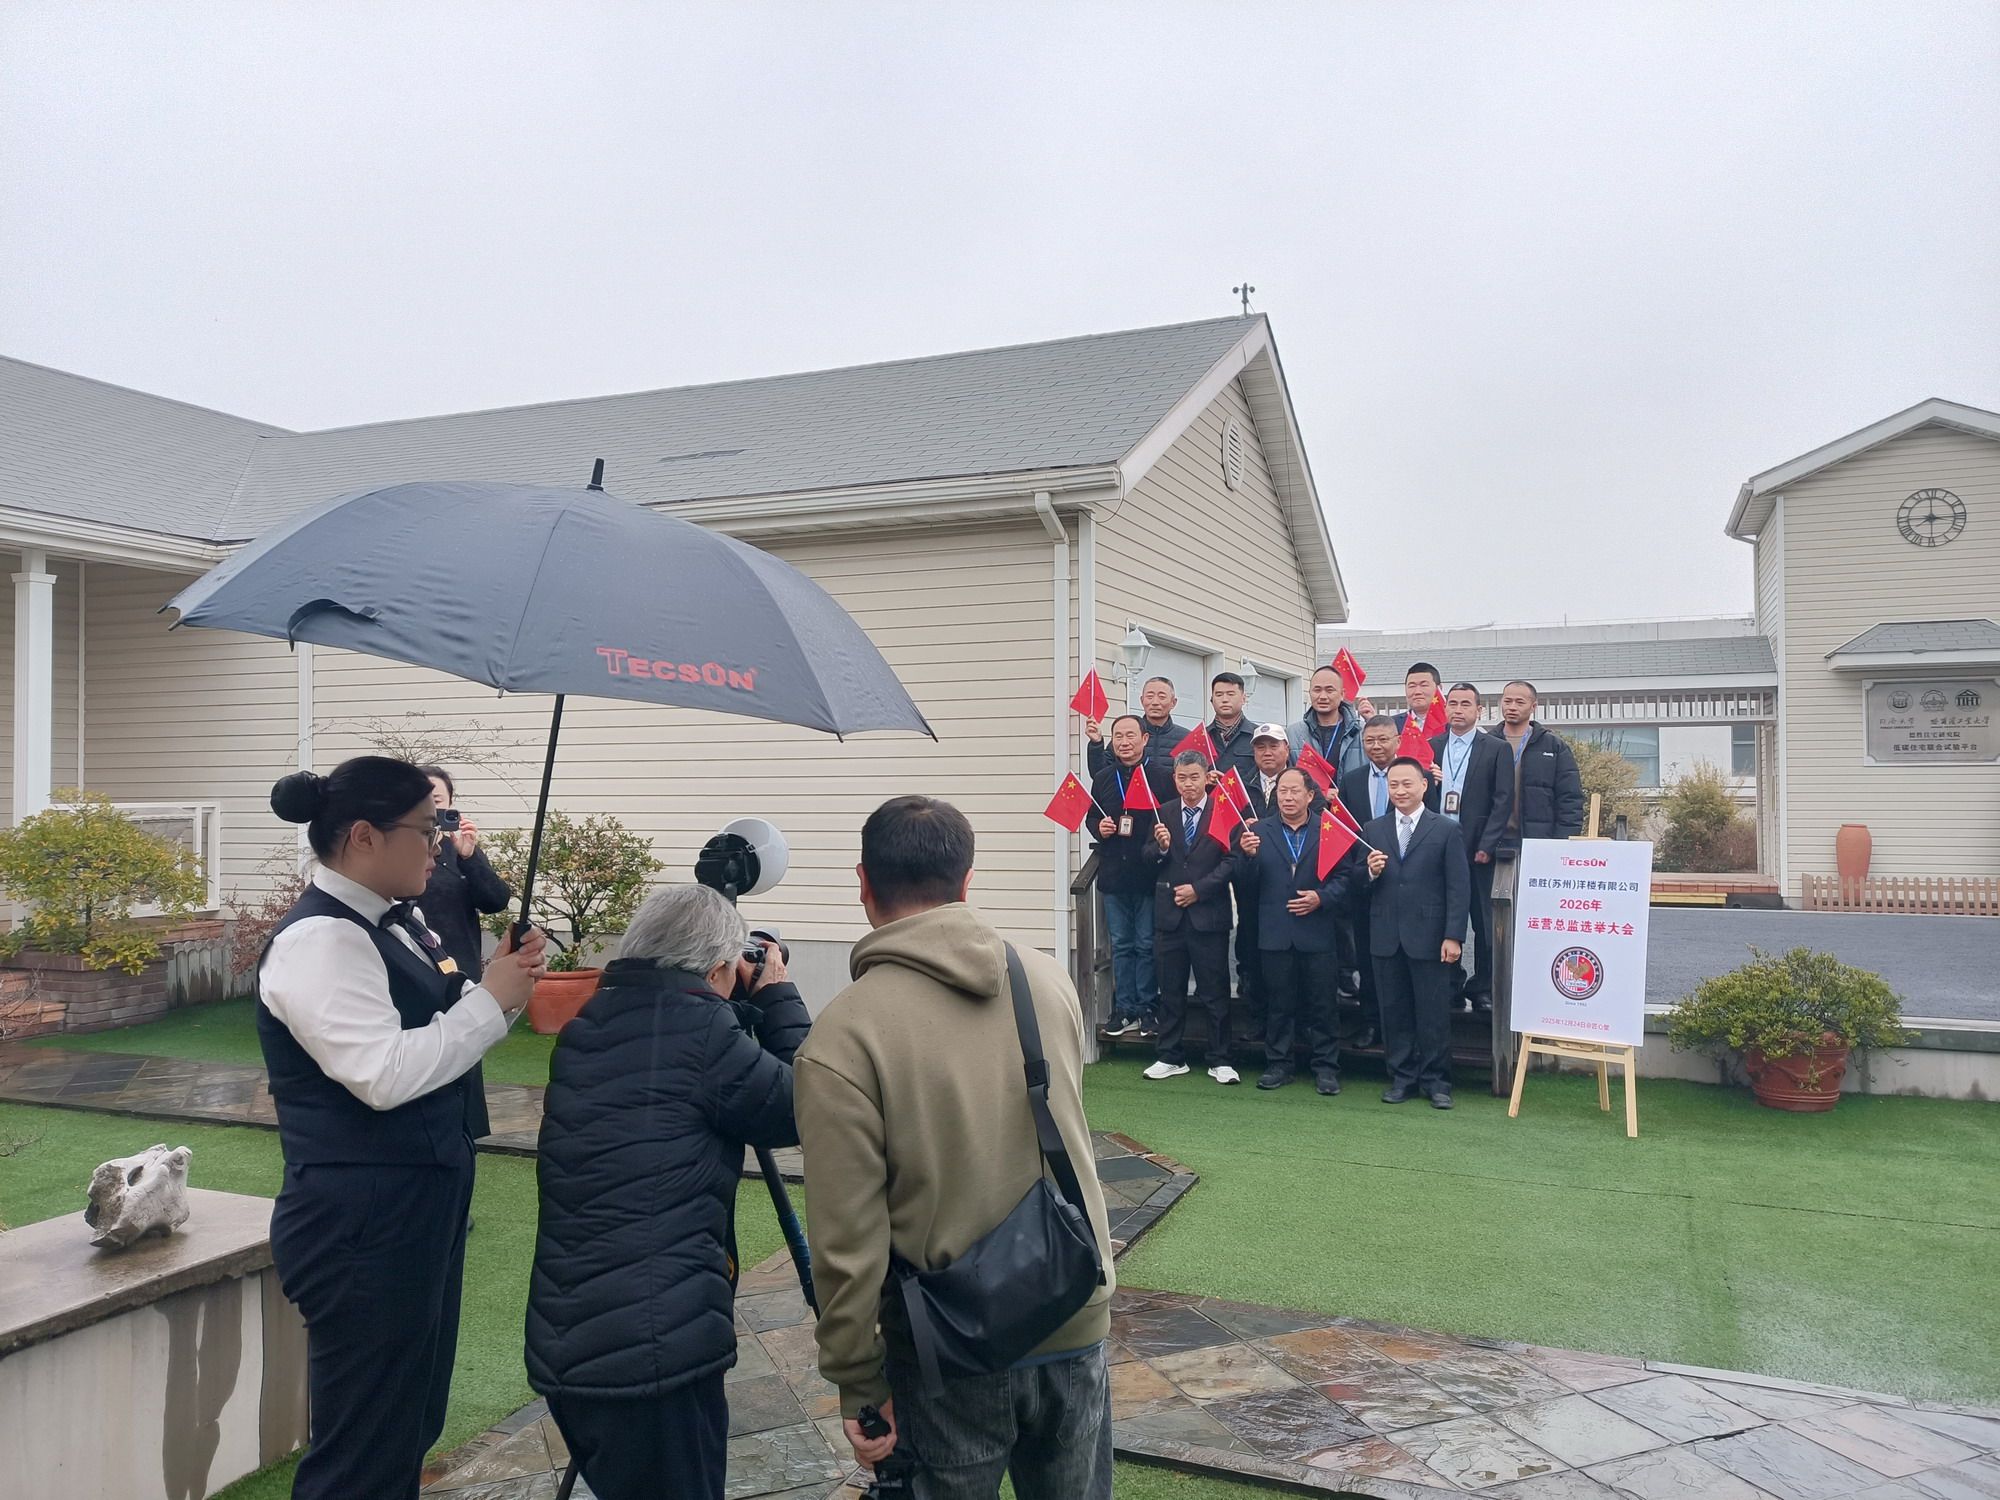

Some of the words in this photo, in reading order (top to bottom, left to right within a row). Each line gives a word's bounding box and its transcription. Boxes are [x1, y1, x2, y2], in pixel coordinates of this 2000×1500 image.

[1559, 899, 1602, 912] 2026年
[1527, 917, 1634, 936] 运营总监选举大会
